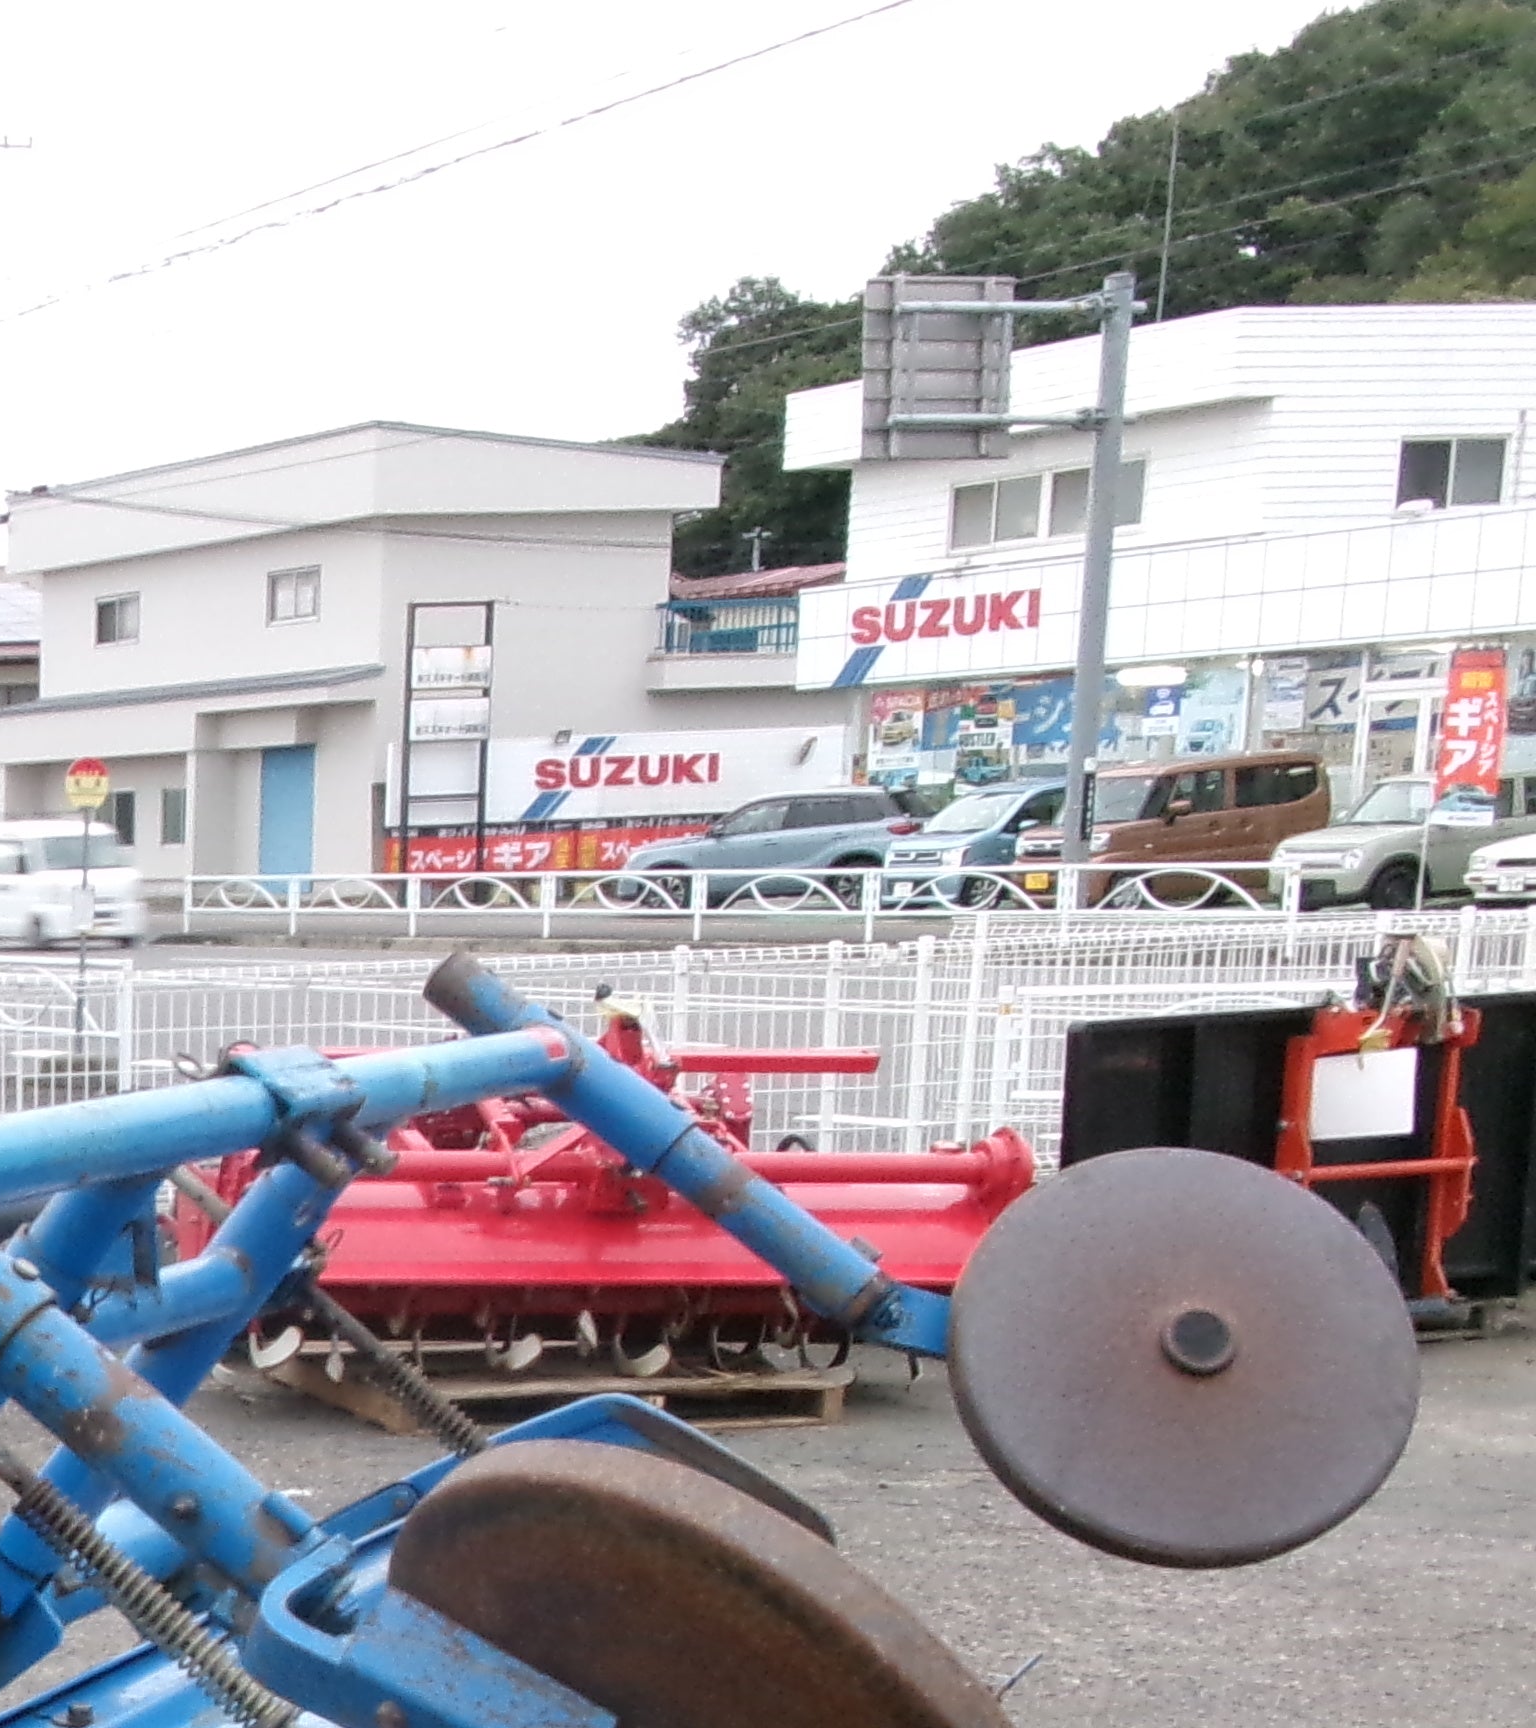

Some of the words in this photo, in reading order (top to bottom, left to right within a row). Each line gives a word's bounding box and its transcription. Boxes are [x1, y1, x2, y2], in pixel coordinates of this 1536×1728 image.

[850, 588, 1041, 644] SUZUKI
[1433, 697, 1483, 777] ギア
[534, 752, 720, 790] SUZUKI
